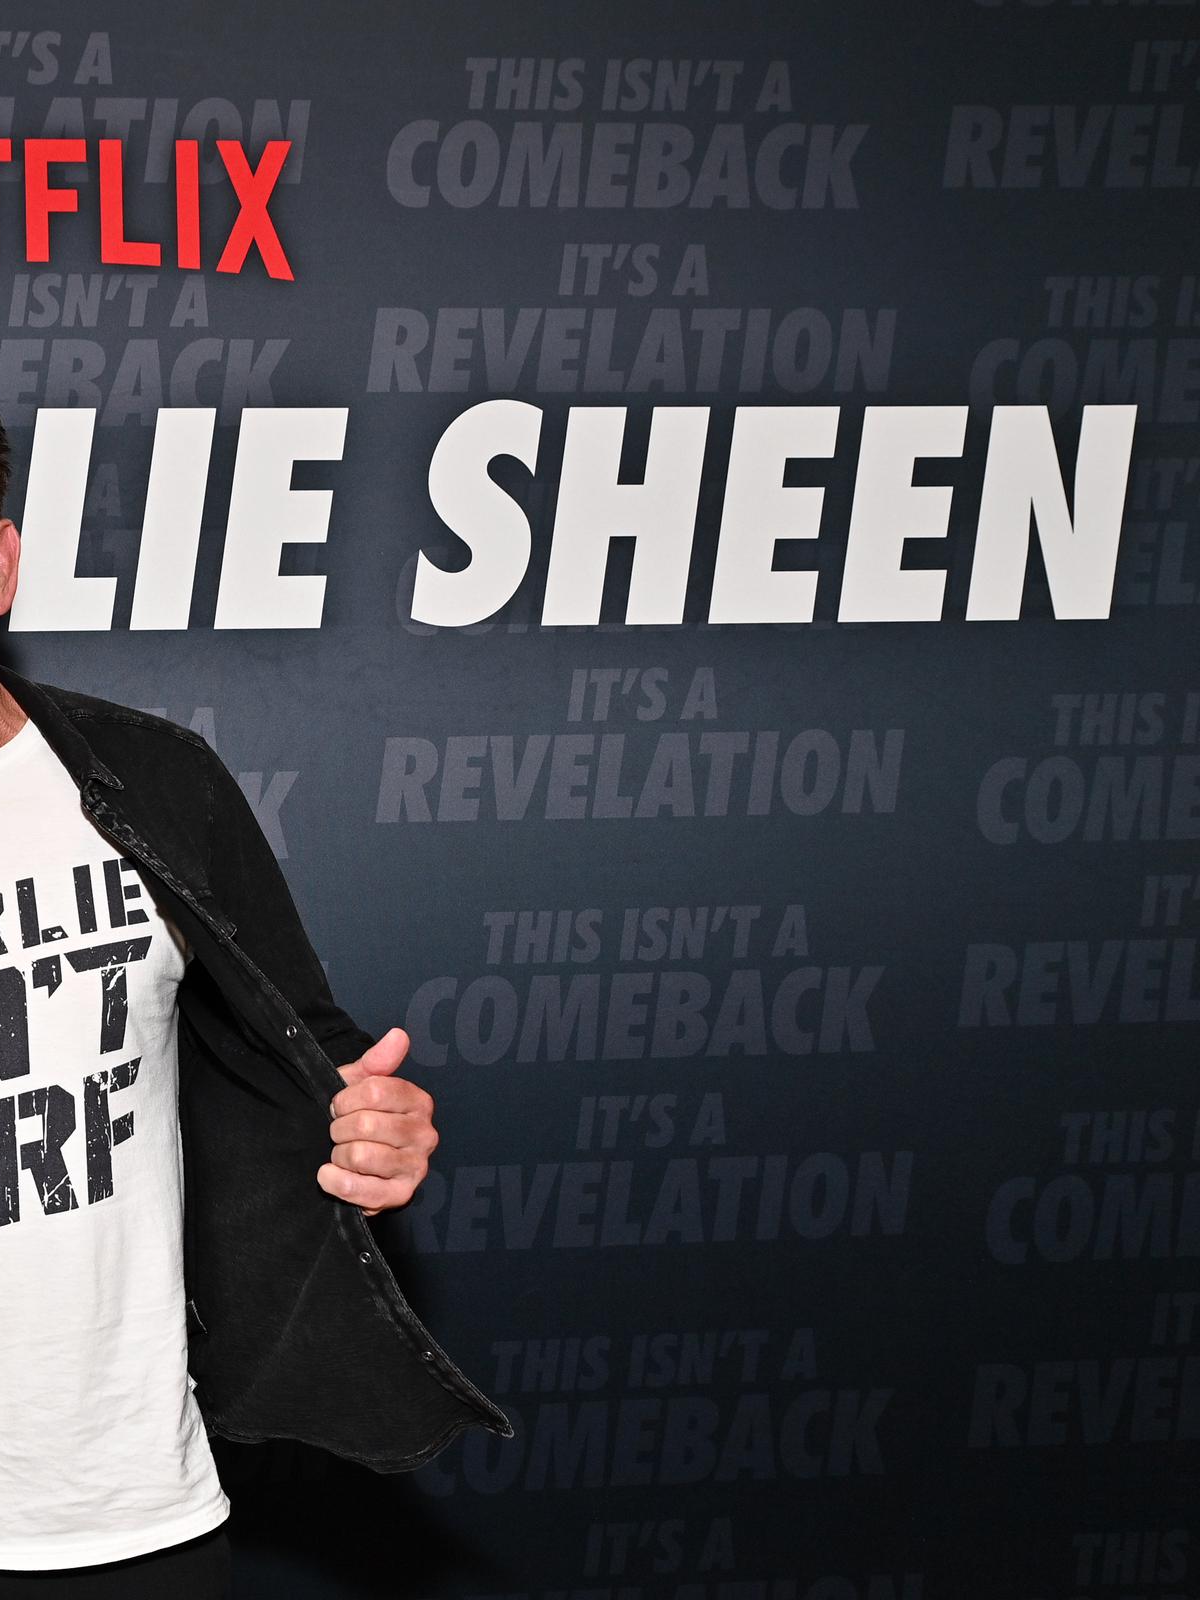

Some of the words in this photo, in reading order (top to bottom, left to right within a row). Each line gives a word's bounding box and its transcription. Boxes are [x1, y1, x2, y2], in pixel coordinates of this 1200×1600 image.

[74, 32, 112, 84] A
[465, 57, 584, 111] THIS
[602, 59, 744, 111] ISN'T
[755, 61, 792, 112] A
[1128, 40, 1200, 92] IT'
[386, 119, 869, 210] COMEBACK
[942, 104, 1200, 188] REVEL
[558, 243, 659, 297] IT'S
[672, 244, 709, 296] A
[7, 274, 158, 328] ISN'T
[169, 276, 210, 328] A
[1044, 274, 1160, 329] THIS
[366, 307, 897, 393] REVELATION
[1132, 457, 1200, 510] IT'
[408, 399, 1140, 629] SHEEN
[567, 668, 668, 722] IT'S
[680, 668, 718, 720] A
[1051, 692, 1166, 746] THIS
[375, 728, 905, 824] REVELATION
[483, 909, 602, 964] THIS
[620, 905, 761, 961] ISN'T
[772, 904, 808, 956] A
[405, 965, 885, 1067] COMEBACK
[576, 1093, 677, 1150] IT'S
[690, 1093, 726, 1145] A
[1060, 1109, 1175, 1164] THIS
[492, 1335, 611, 1393] THIS
[628, 1330, 769, 1387] ISN'T
[781, 1328, 817, 1379] A
[583, 1519, 685, 1577] IT'S
[698, 1517, 735, 1571] A
[1072, 1528, 1190, 1587] THIS
